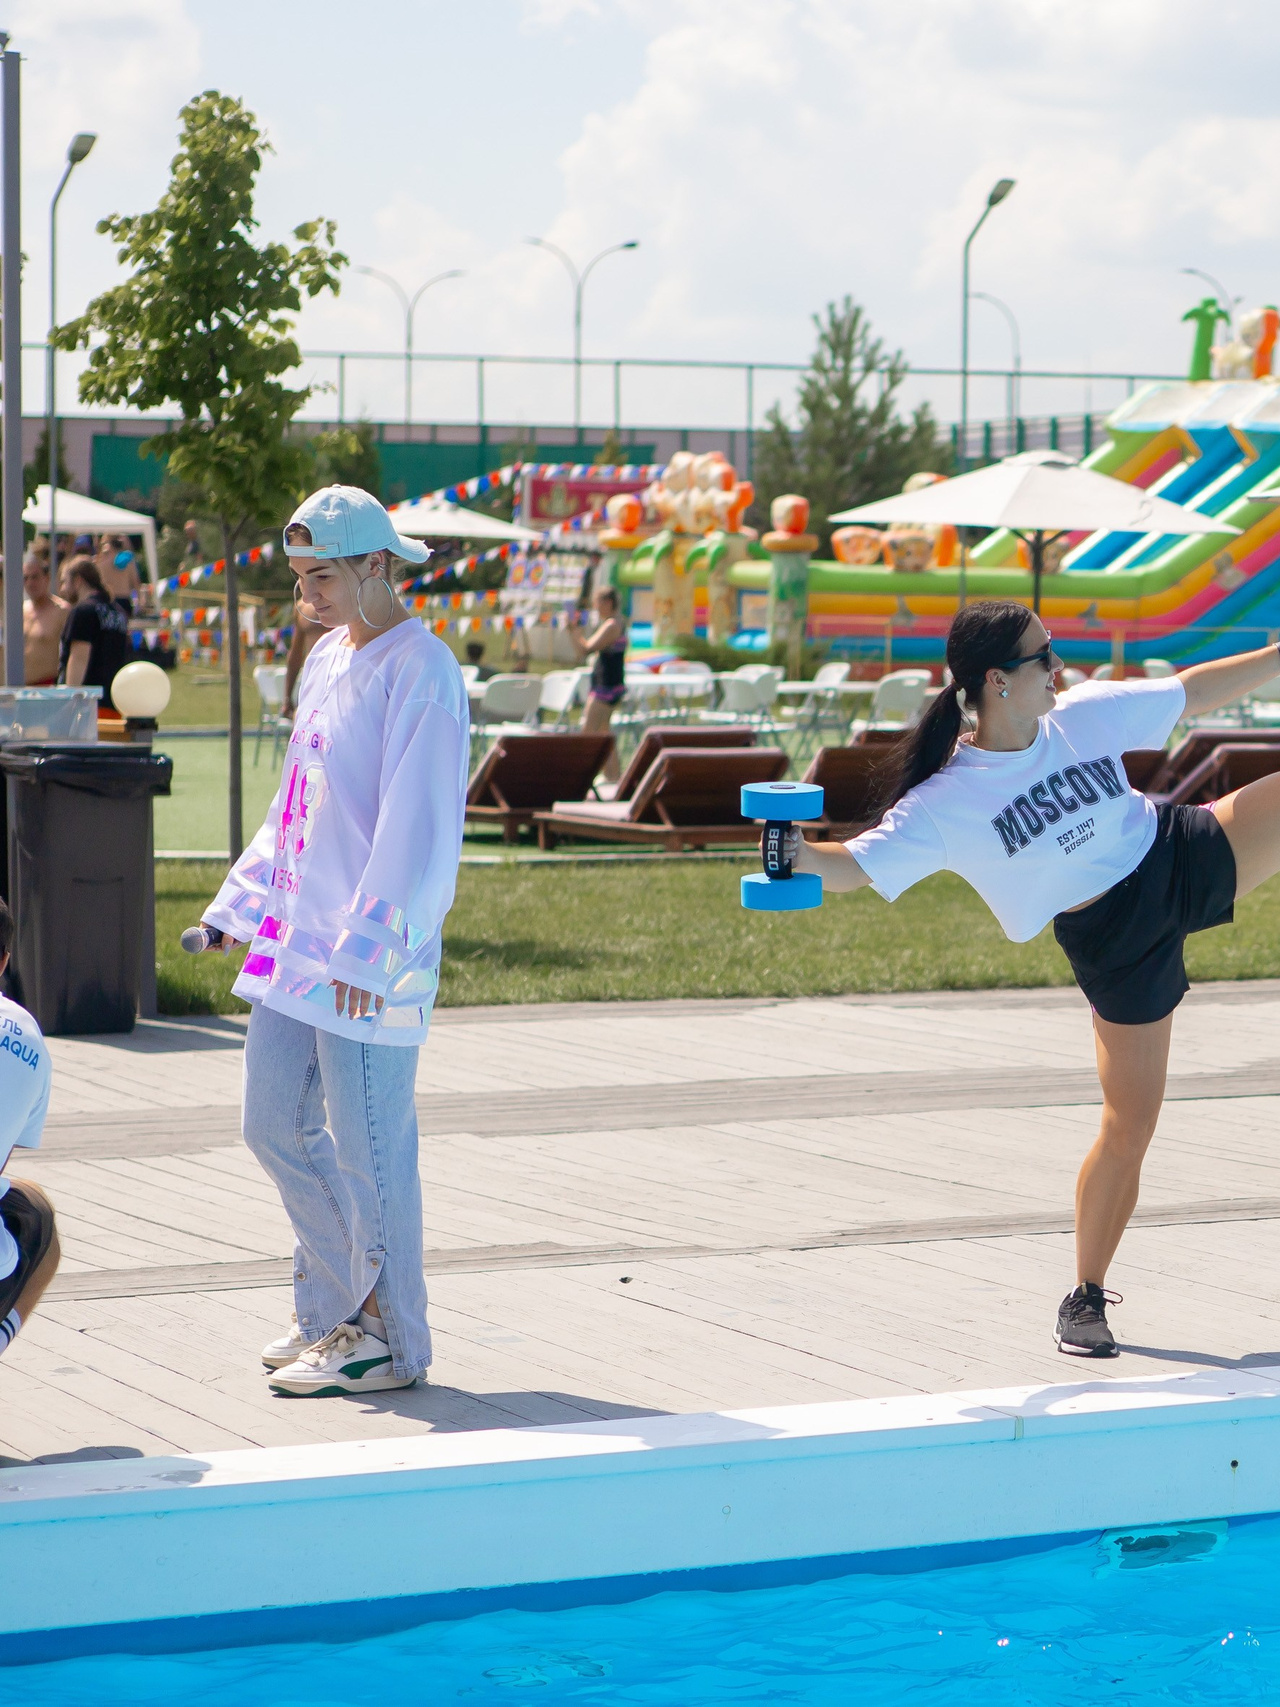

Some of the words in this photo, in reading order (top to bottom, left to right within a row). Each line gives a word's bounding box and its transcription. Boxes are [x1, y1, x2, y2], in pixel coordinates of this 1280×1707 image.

[991, 755, 1126, 858] MOSCOW
[1056, 829, 1077, 847] EST.
[1076, 817, 1095, 835] 1147
[1064, 830, 1095, 855] RUSSIA
[768, 828, 780, 871] BECO
[0, 1016, 23, 1036] ЛЬ
[0, 1035, 39, 1071] AQUA
